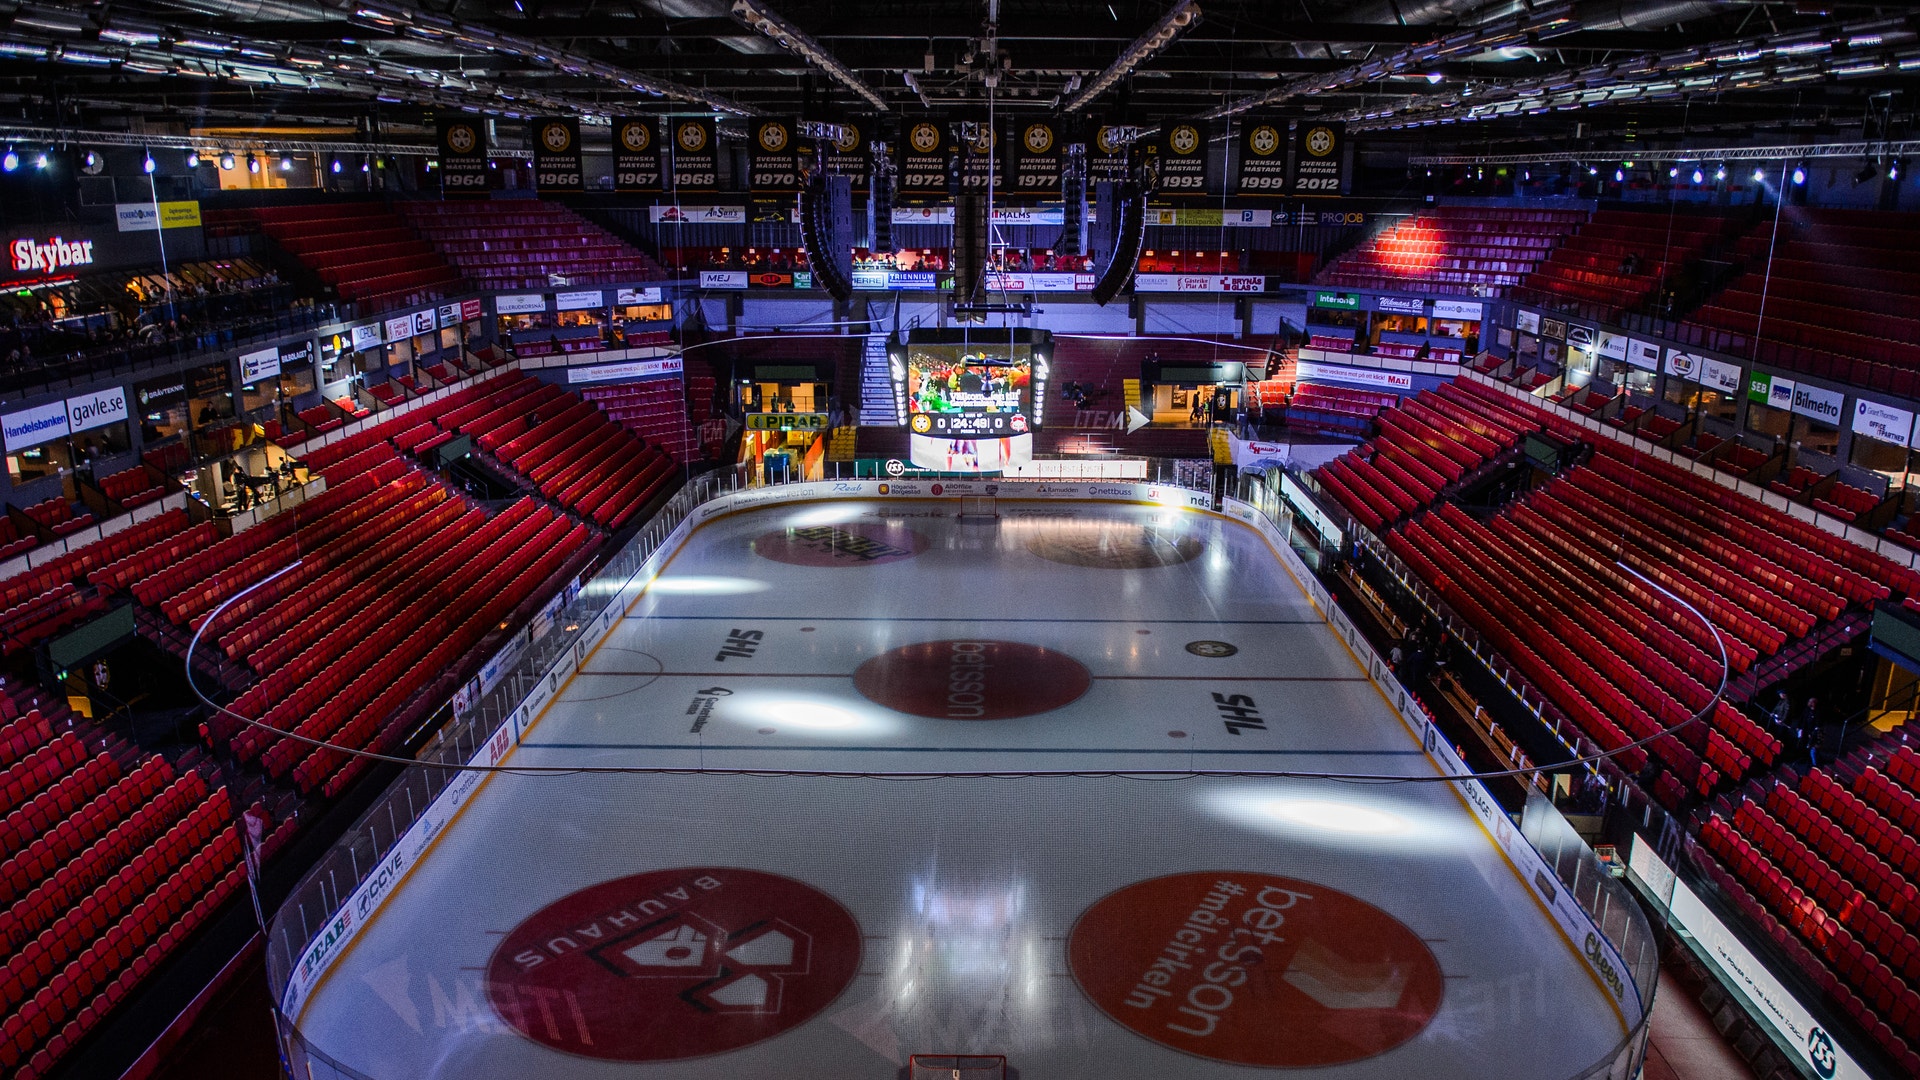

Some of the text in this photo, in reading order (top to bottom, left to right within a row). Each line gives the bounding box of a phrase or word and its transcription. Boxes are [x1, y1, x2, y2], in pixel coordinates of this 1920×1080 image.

[444, 174, 486, 186] 1964
[539, 174, 580, 184] 1966
[618, 173, 658, 184] 1967
[674, 174, 715, 185] 1968
[754, 174, 795, 184] 1970
[904, 174, 945, 186] 1972
[1018, 176, 1058, 186] 1977
[1162, 176, 1204, 188] 1993
[1241, 176, 1283, 188] 1999
[1296, 178, 1340, 190] 2012
[12, 236, 93, 274] Skybar
[707, 274, 730, 282] MEJ
[662, 361, 682, 370] MAXI
[1388, 376, 1409, 385] MAXI
[1751, 380, 1767, 394] SEB
[1795, 390, 1838, 417] Bilmetro
[72, 396, 124, 426] gavle.se
[1867, 406, 1879, 417] Grant
[5, 413, 67, 440] Handelsbanken
[938, 418, 946, 428] 0
[954, 418, 987, 429] 24:49
[995, 418, 1003, 428] 0
[1868, 420, 1886, 431] OFFICE
[1097, 487, 1132, 496] nettbuss
[714, 628, 764, 662] SHL
[947, 642, 997, 717] betsson
[1211, 692, 1268, 736] SHL
[490, 727, 510, 766] ABB
[369, 852, 403, 900] CCVE
[514, 875, 724, 970] BAUHAUS
[304, 916, 346, 976] PEAB
[1124, 880, 1248, 1010] #målcirkeln
[1166, 885, 1314, 1038] betsson
[1717, 946, 1726, 958] THE
[1727, 957, 1744, 978] POWER
[1745, 976, 1753, 986] OF
[1753, 983, 1764, 999] THE
[1764, 996, 1784, 1020] HUMAN
[1808, 1035, 1836, 1070] ISS
